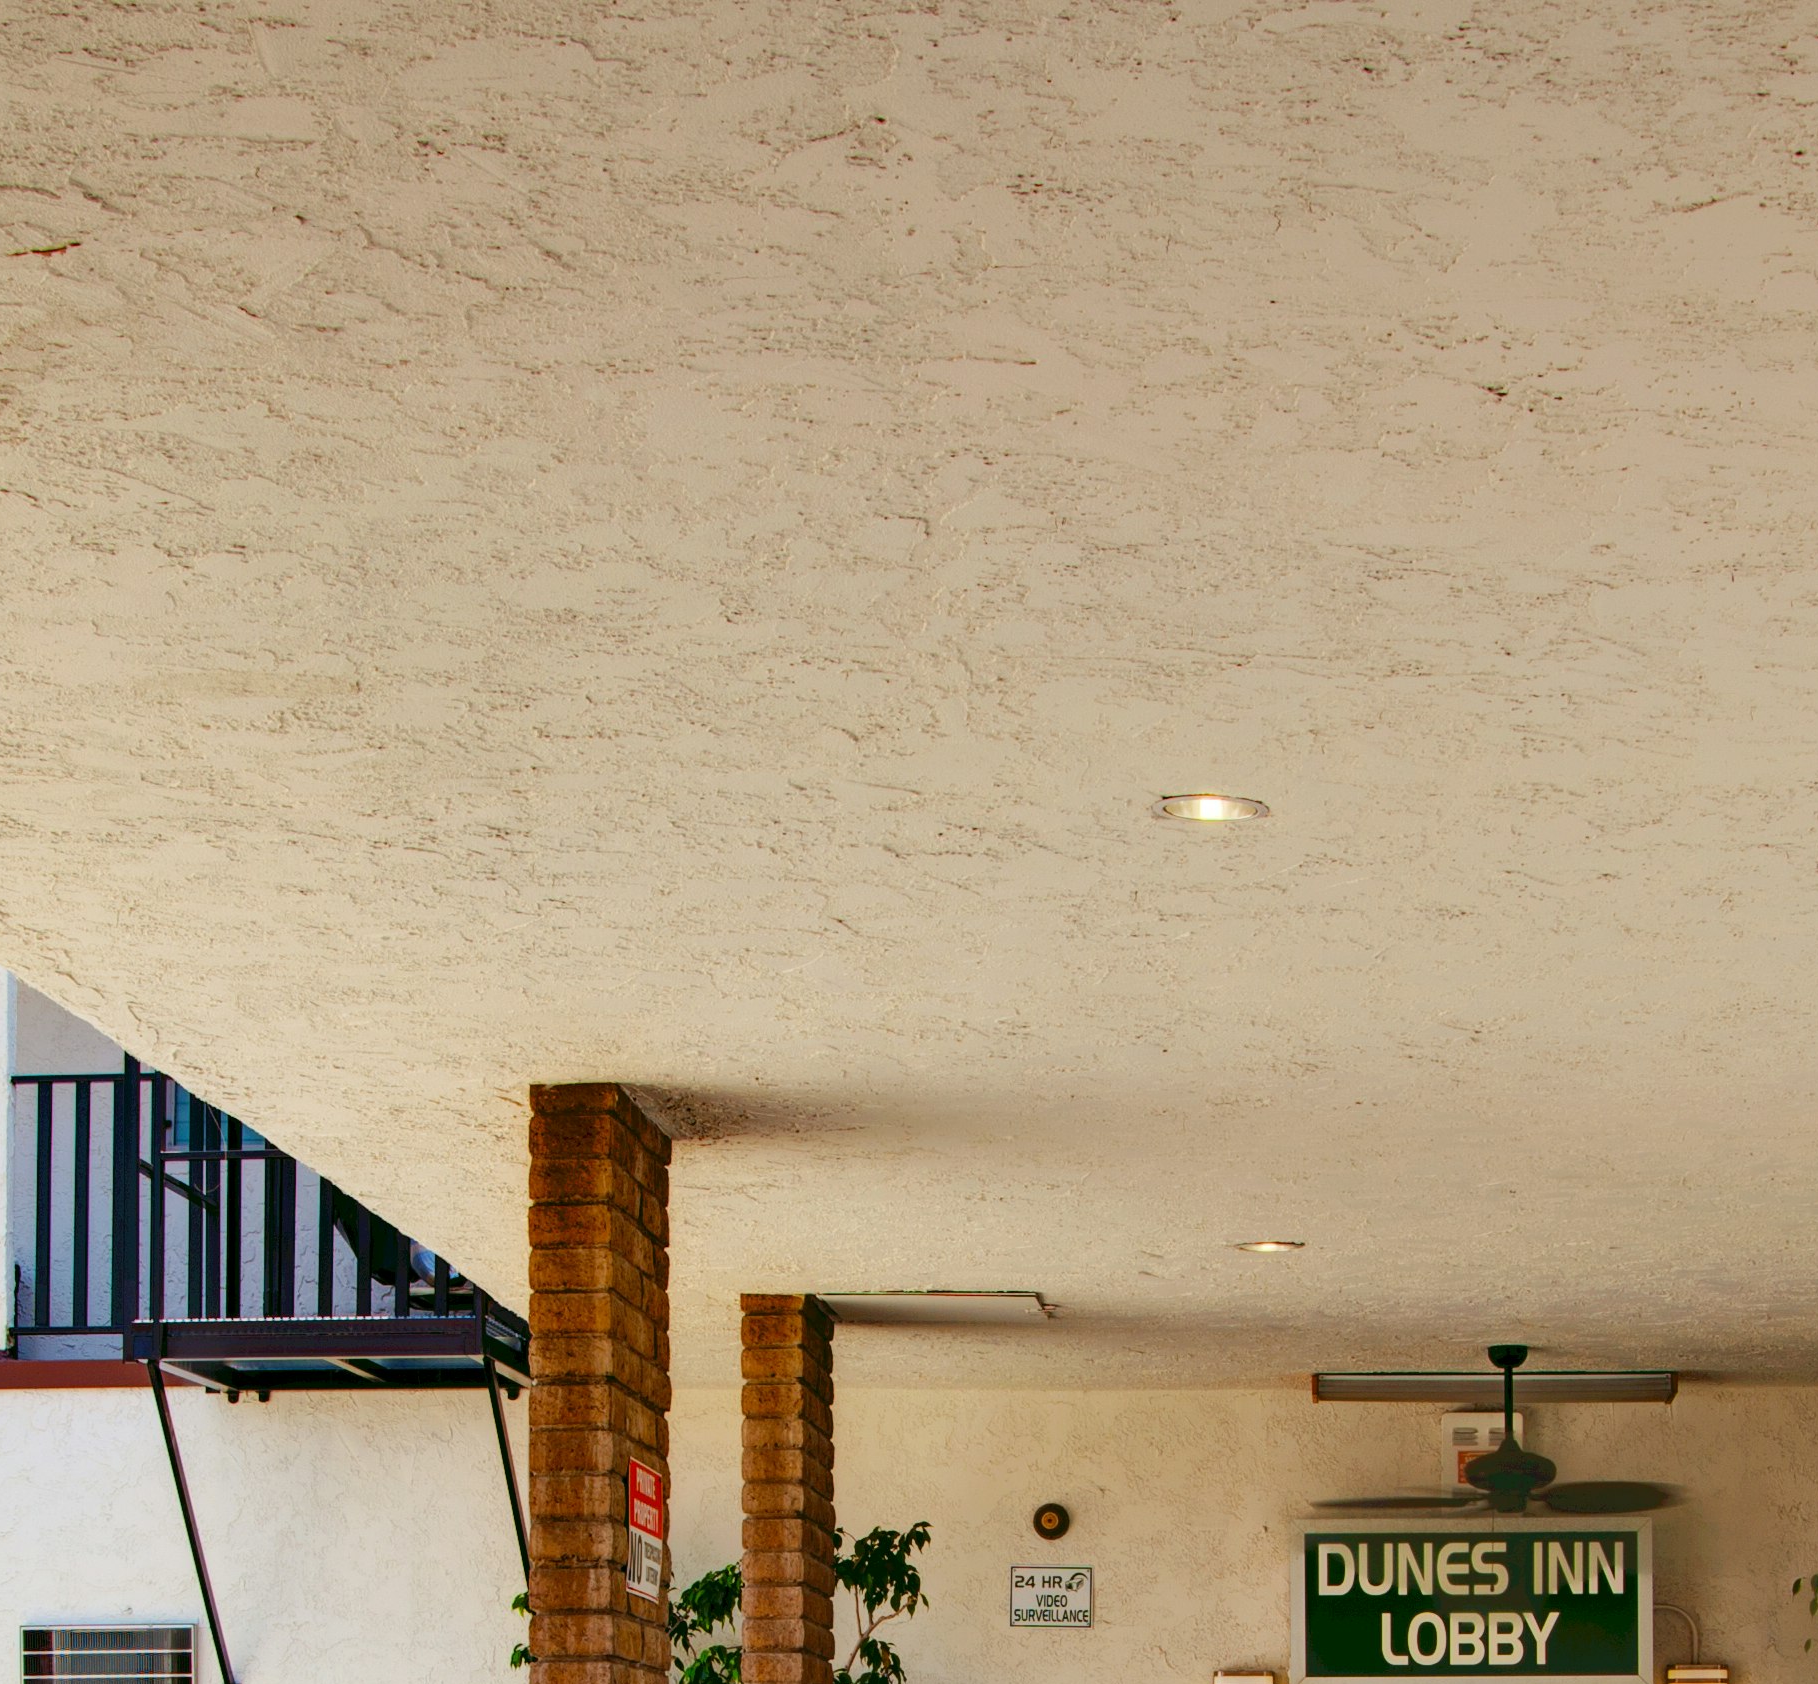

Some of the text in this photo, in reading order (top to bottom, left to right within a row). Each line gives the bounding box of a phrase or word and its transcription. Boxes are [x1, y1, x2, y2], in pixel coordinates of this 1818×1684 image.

[633, 1497, 659, 1534] PROPERTY
[627, 1529, 643, 1586] NO
[1318, 1541, 1624, 1596] DUNES INN
[1014, 1575, 1063, 1588] 24 HR
[1014, 1608, 1089, 1623] SURVEILLANCE
[1035, 1594, 1068, 1608] VIDEO
[1381, 1611, 1560, 1666] LOBBY
